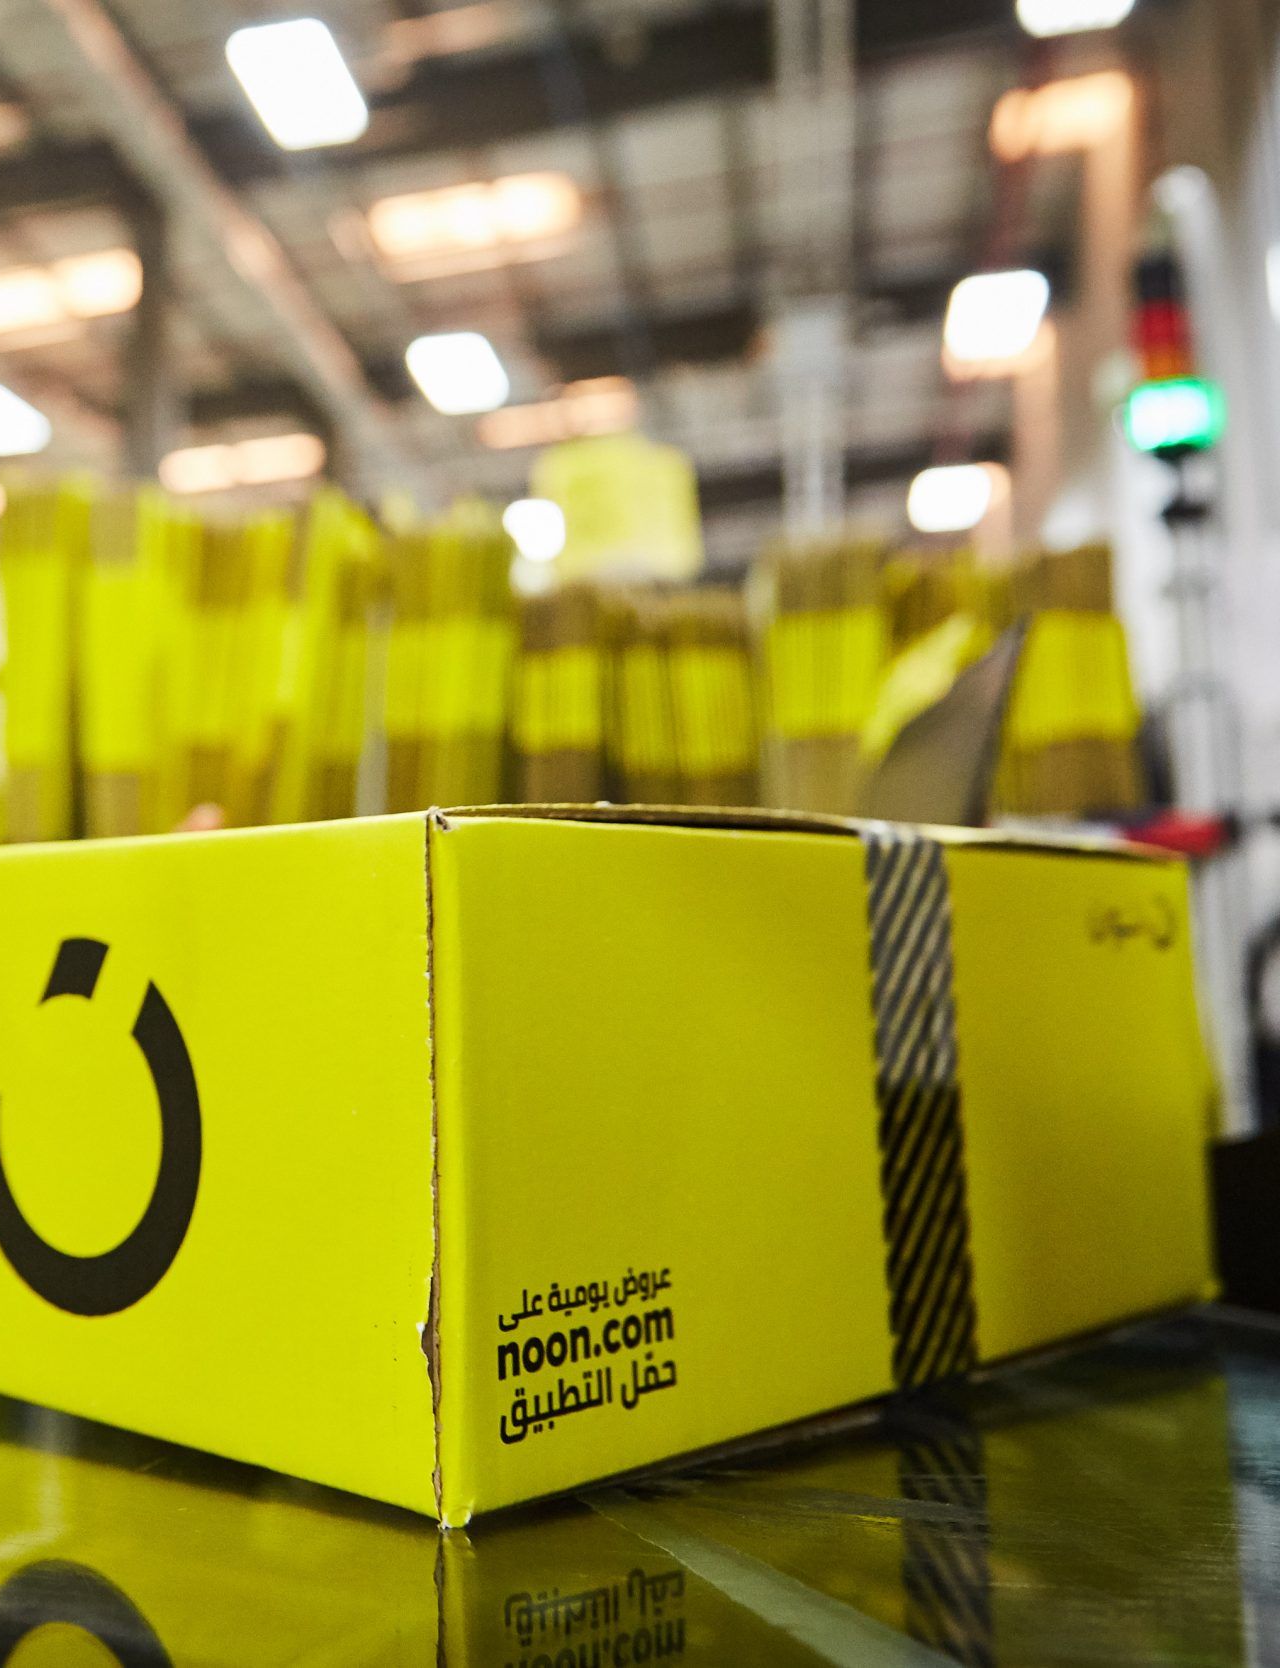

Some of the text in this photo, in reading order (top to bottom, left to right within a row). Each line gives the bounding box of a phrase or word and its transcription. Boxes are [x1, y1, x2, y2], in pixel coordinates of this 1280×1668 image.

[499, 1267, 672, 1331] عروض يومية على
[498, 1307, 674, 1380] noon.com
[500, 1367, 612, 1444] التطبيق
